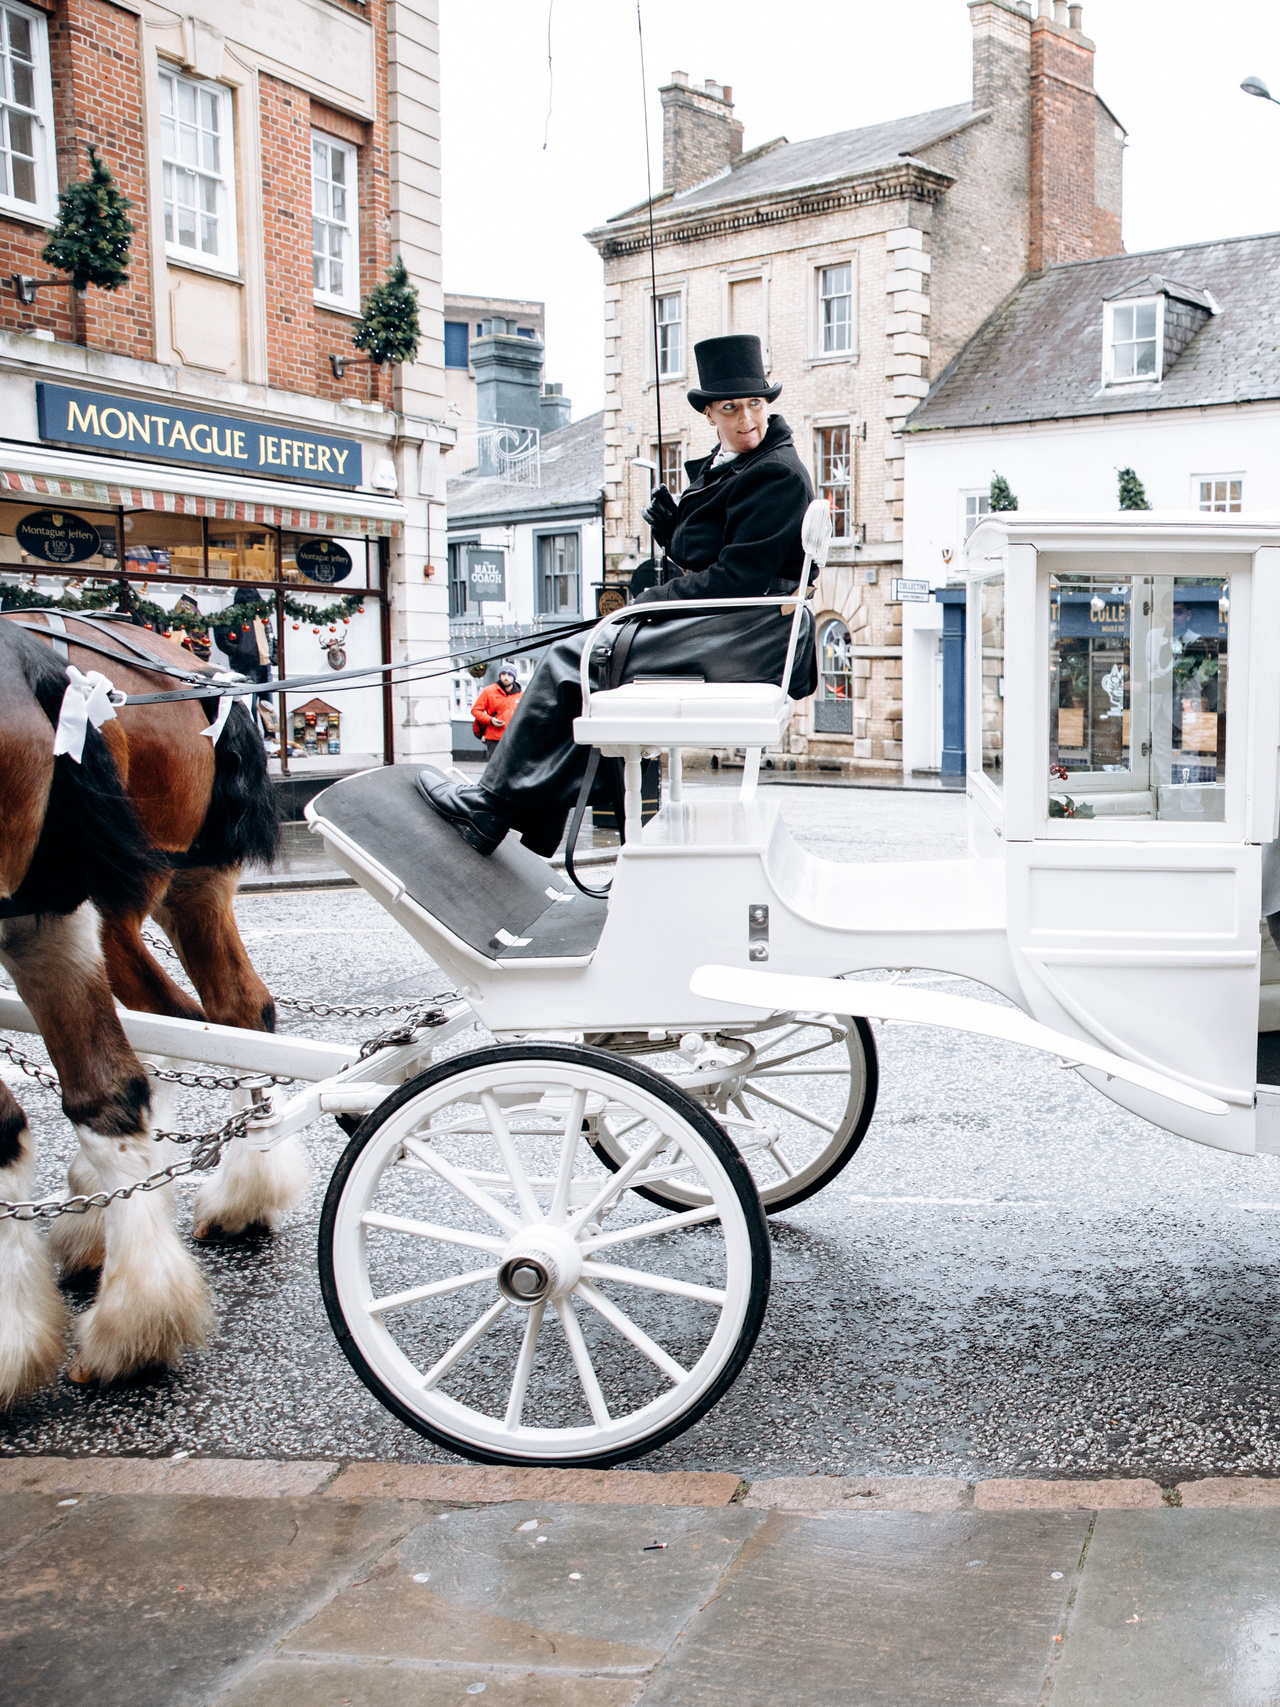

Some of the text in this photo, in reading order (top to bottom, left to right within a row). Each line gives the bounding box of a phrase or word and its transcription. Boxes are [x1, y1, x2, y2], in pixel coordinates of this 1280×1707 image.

[67, 401, 349, 474] MONTAGUE JEFFERY
[22, 525, 94, 542] Montague Jeffery
[52, 540, 68, 548] 100
[300, 552, 329, 563] Montague
[474, 564, 499, 574] MAIL
[471, 573, 502, 583] COACH
[900, 582, 927, 591] COLLECTIVE
